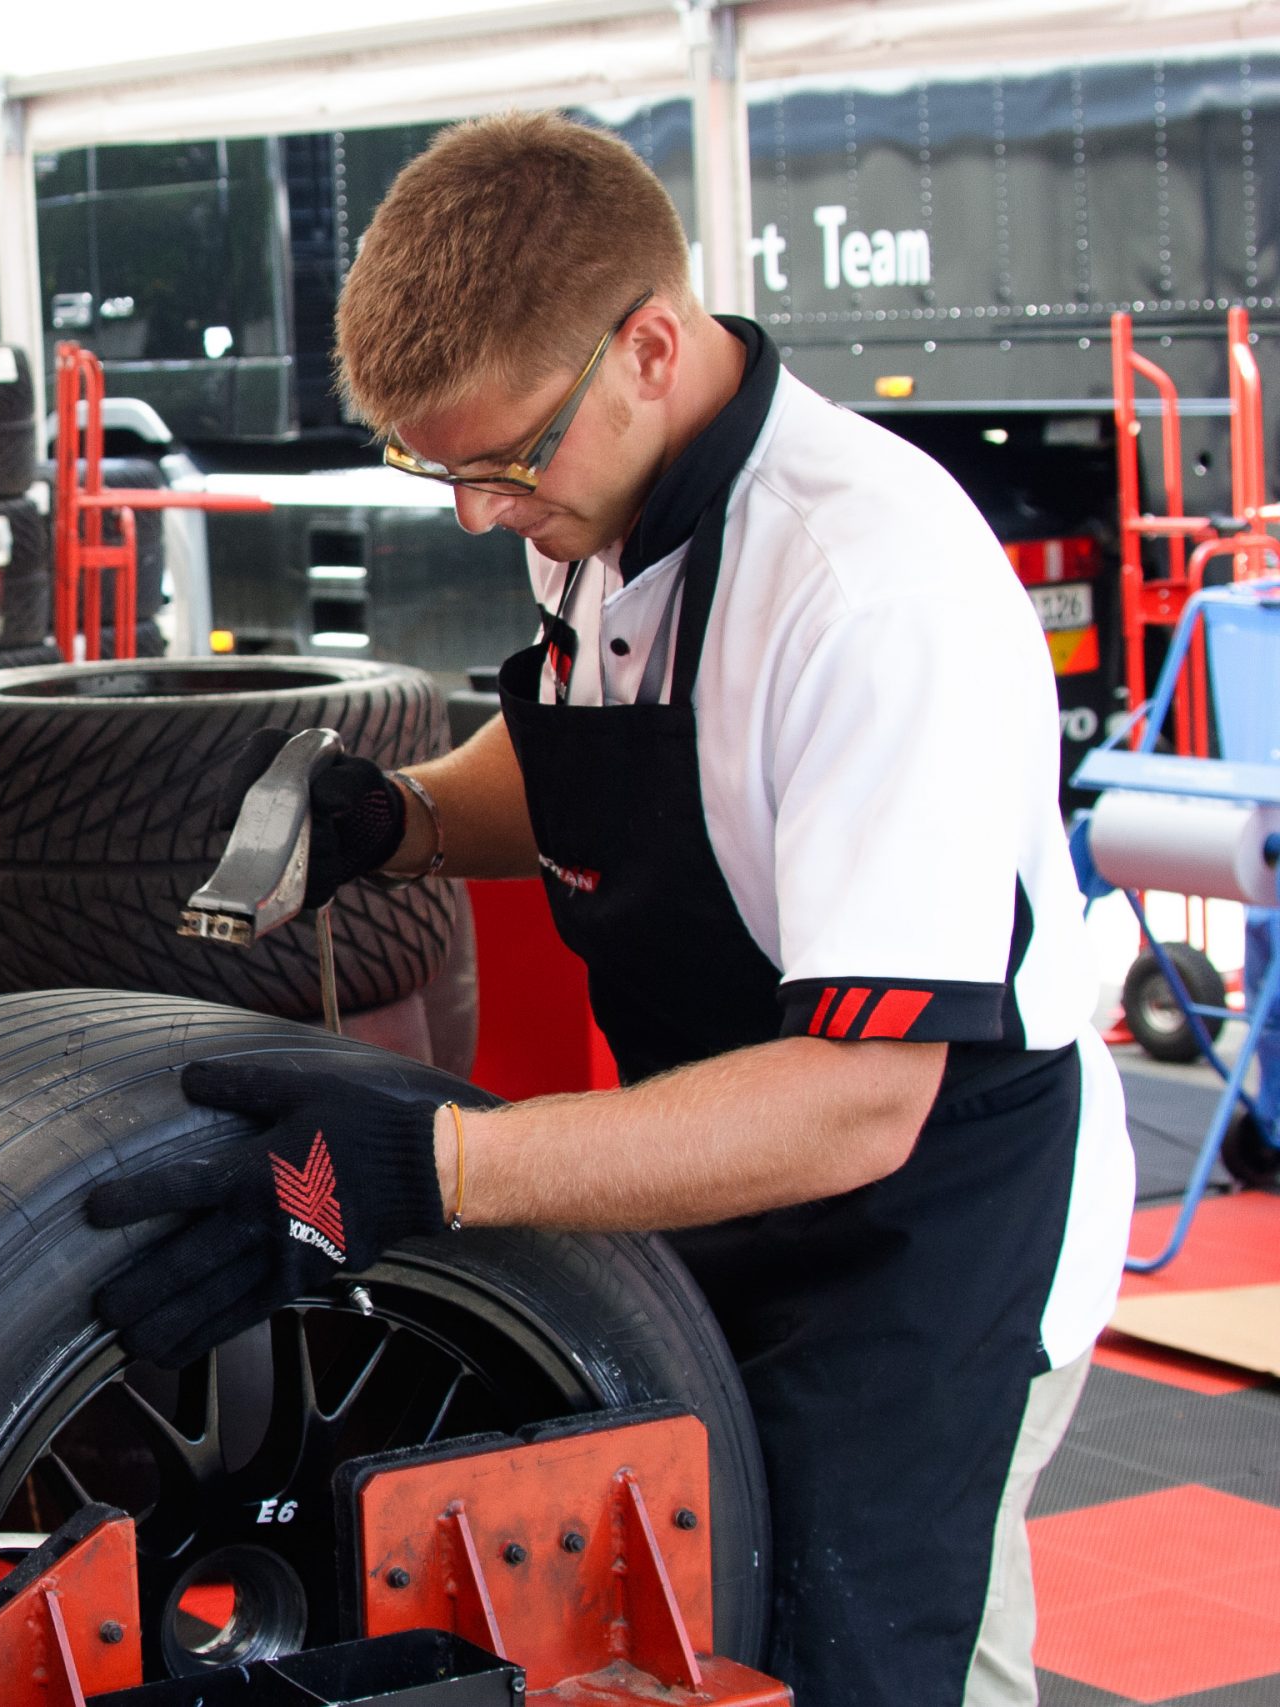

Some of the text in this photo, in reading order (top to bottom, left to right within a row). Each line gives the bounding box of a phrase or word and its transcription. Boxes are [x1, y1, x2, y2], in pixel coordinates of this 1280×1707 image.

[813, 204, 932, 290] Team
[289, 1218, 346, 1264] YOKOHAMA
[256, 1499, 299, 1524] E6
